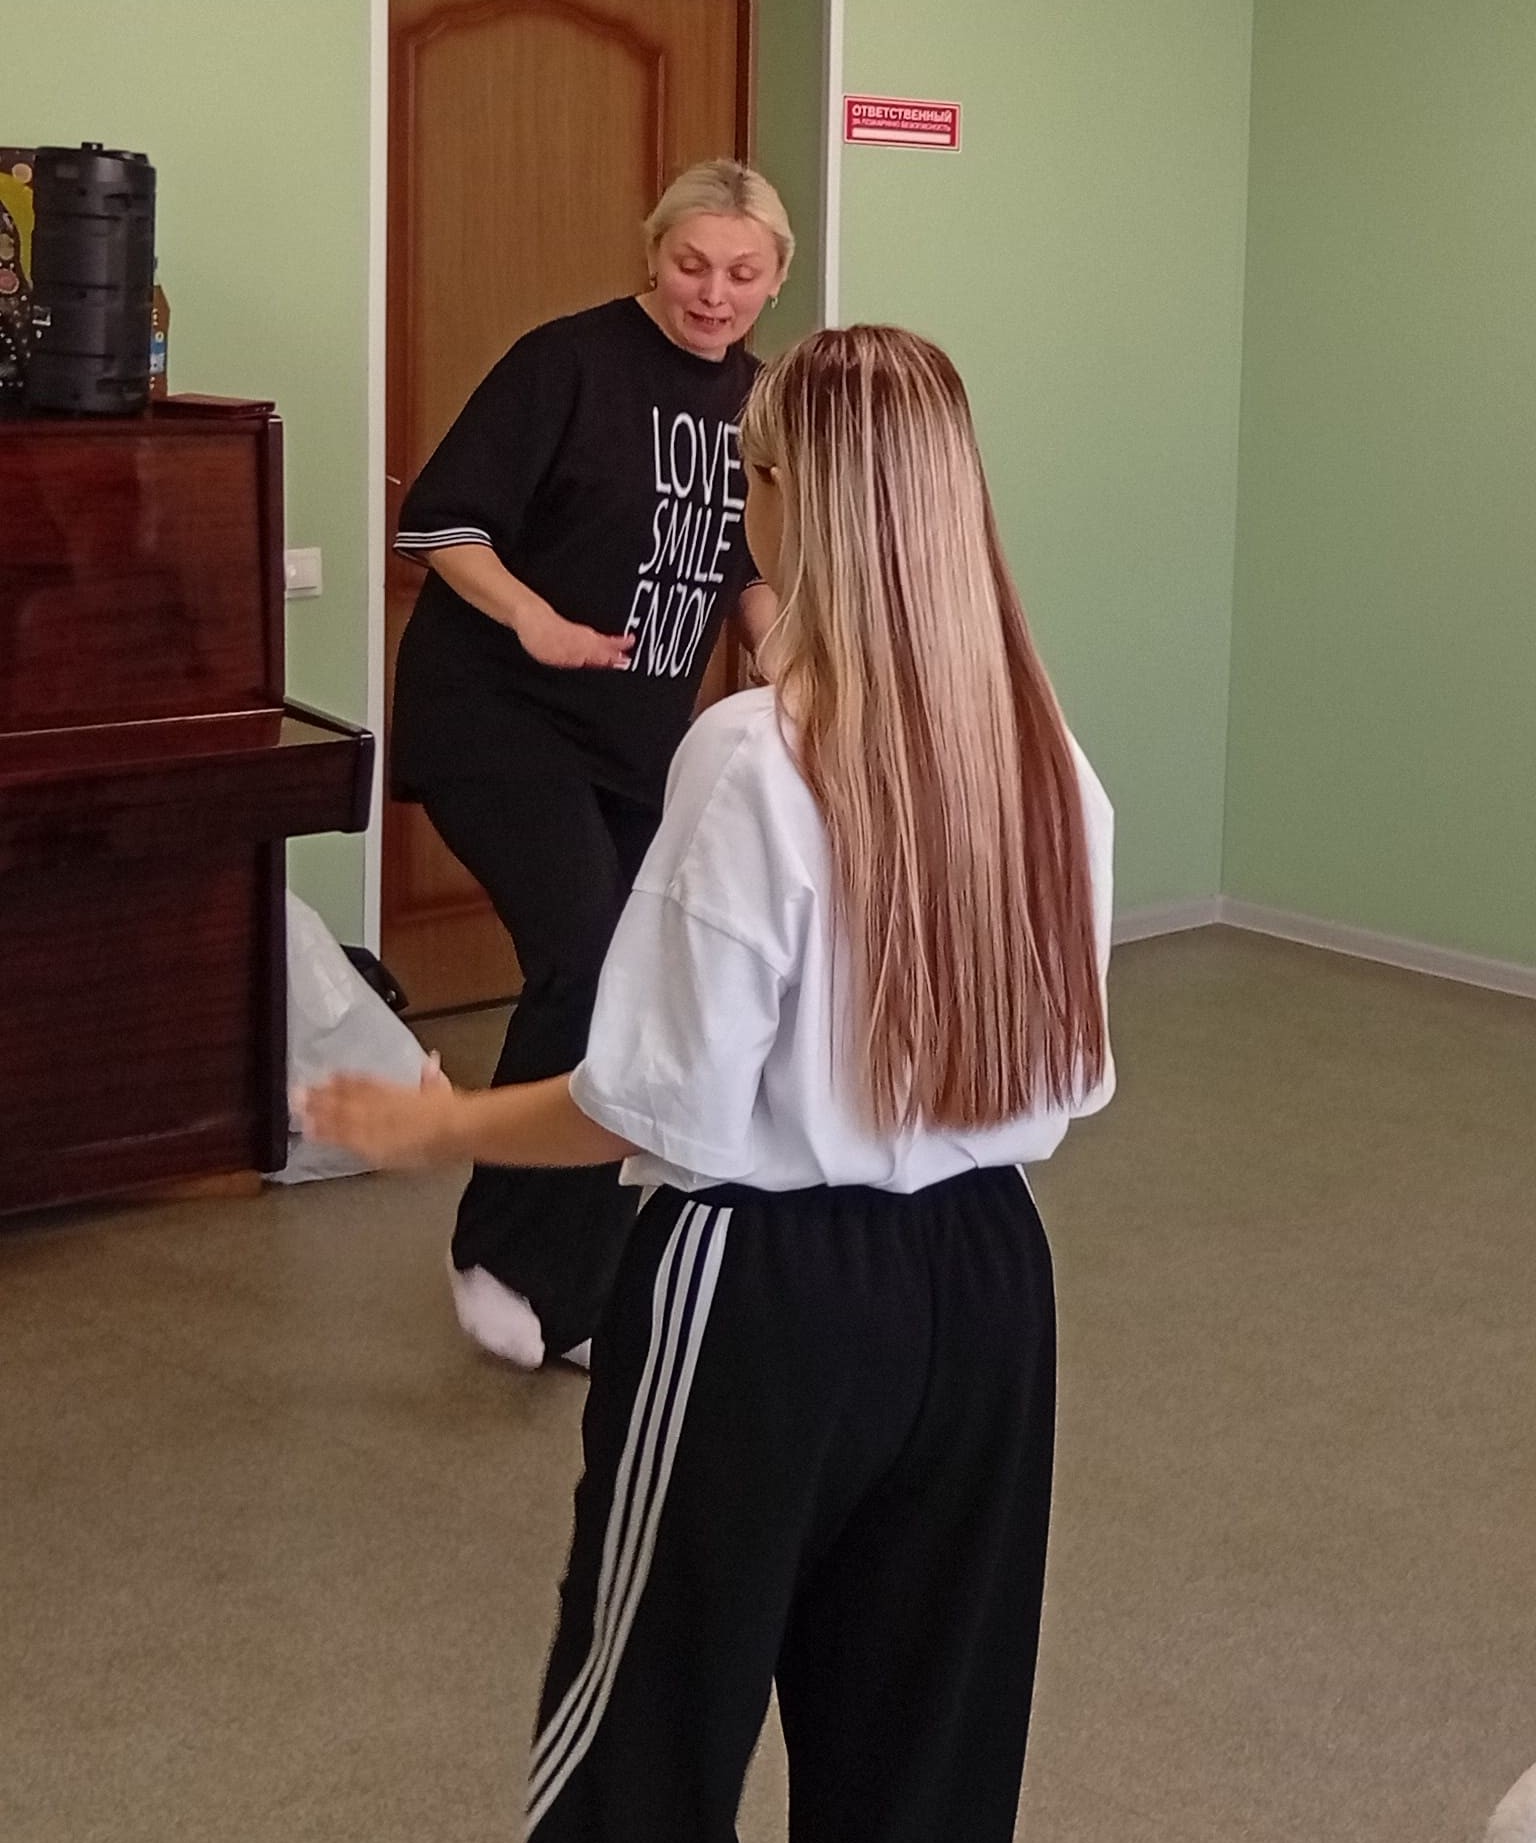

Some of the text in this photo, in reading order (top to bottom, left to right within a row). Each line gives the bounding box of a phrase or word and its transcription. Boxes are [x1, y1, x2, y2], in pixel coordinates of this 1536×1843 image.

[851, 104, 952, 123] ОТВЕТСТВЕННЫЙ
[652, 405, 745, 510] LOVE
[637, 497, 741, 583] SMILE
[617, 579, 717, 678] ENJOY
